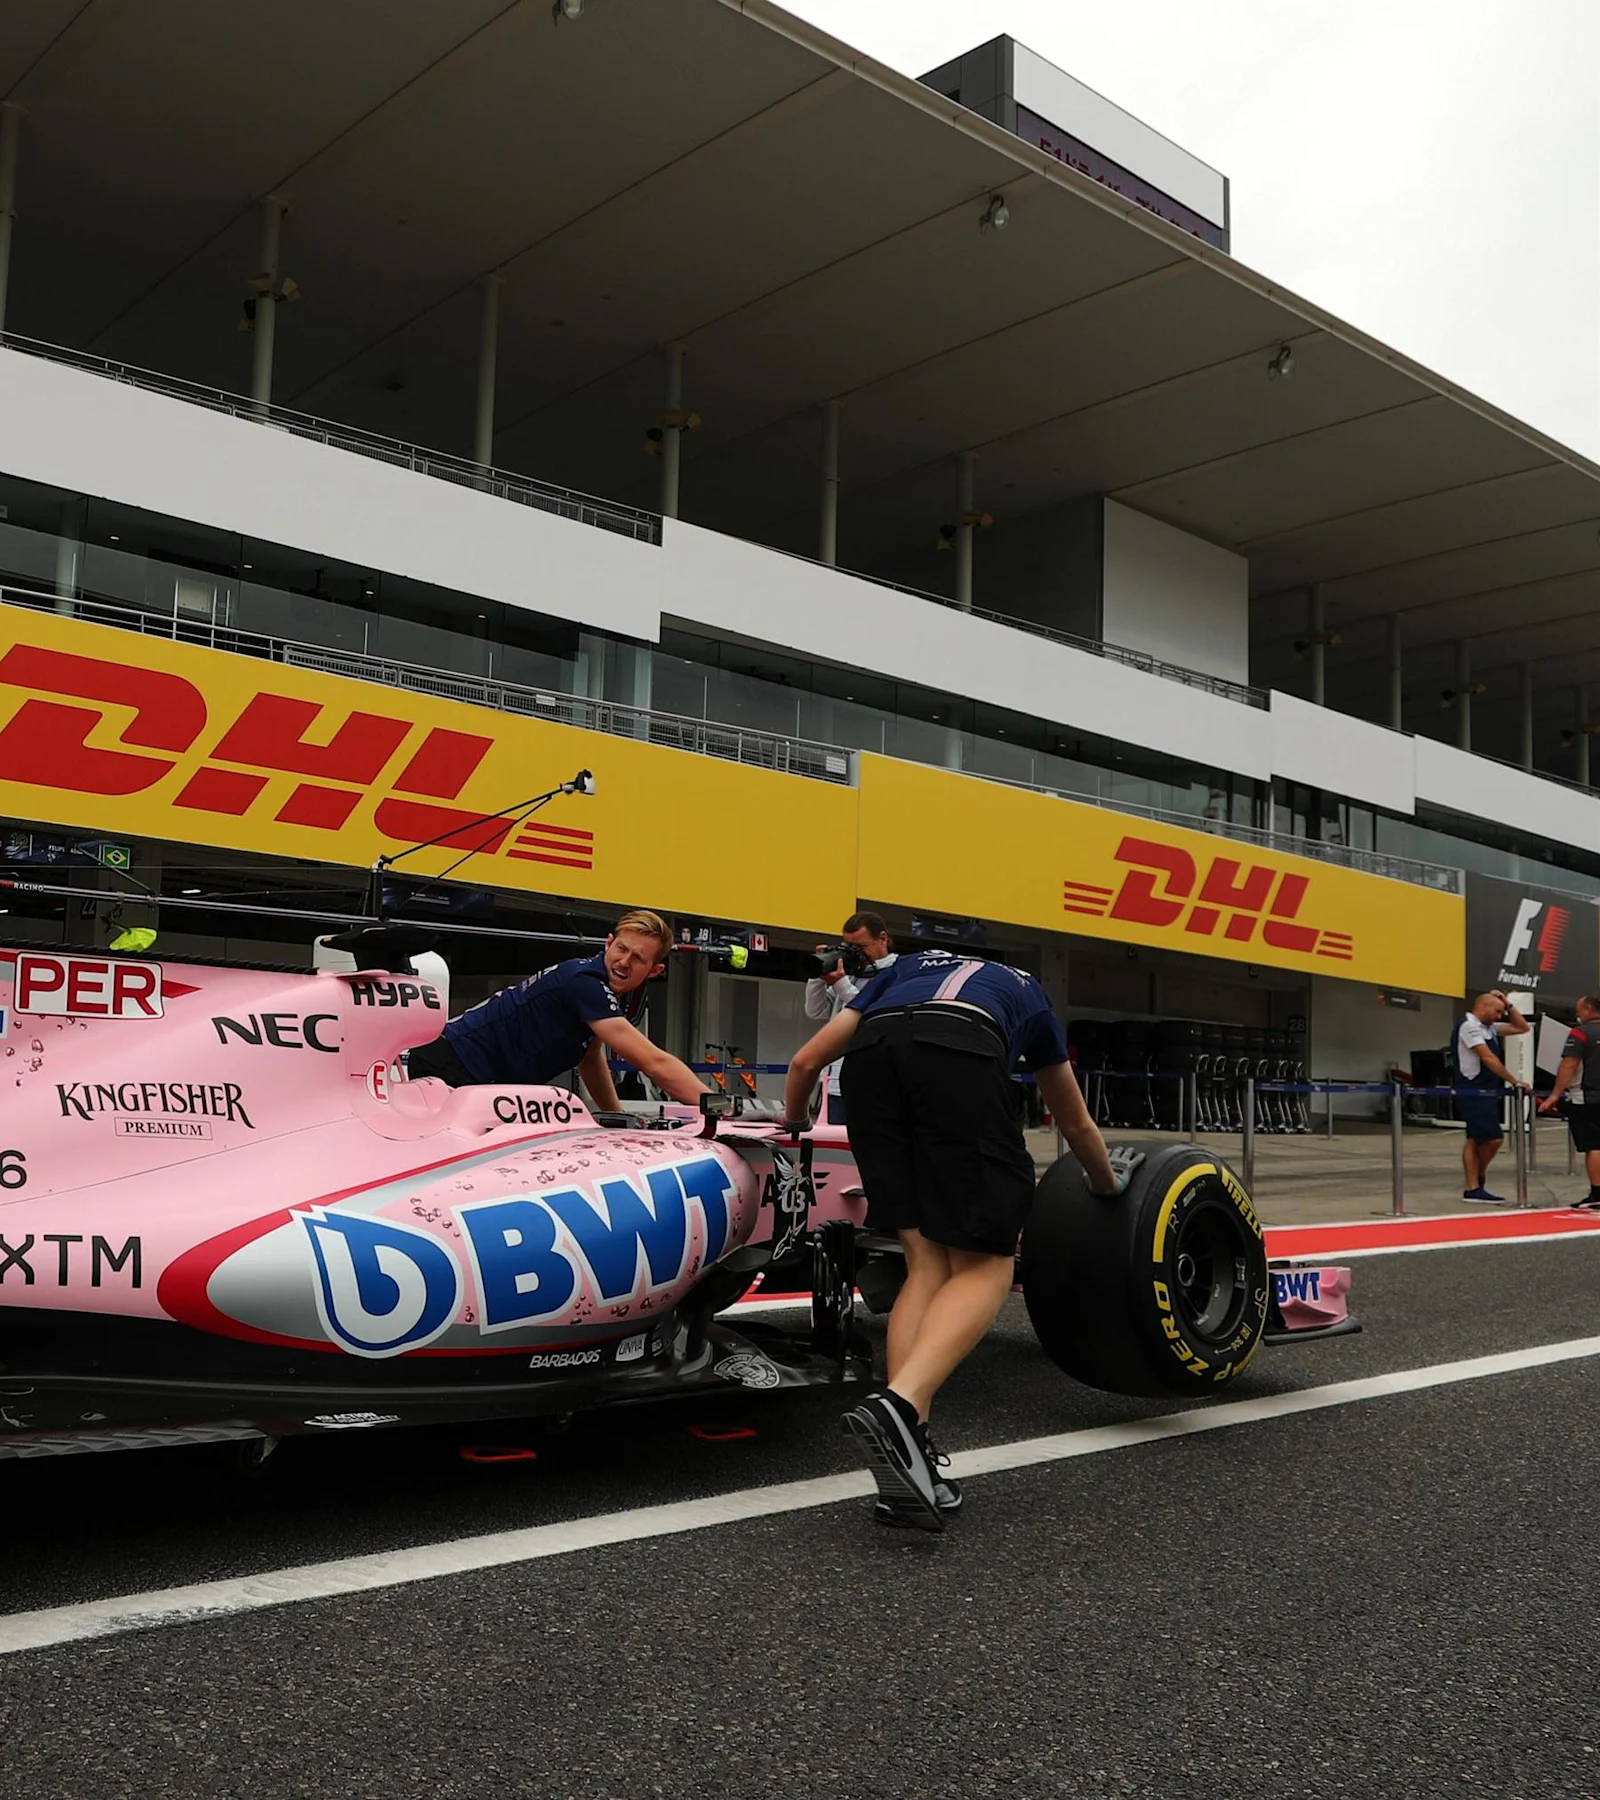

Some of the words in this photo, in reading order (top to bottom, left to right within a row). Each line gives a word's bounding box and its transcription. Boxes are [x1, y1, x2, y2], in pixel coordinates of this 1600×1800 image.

[13, 881, 44, 892] RACING
[1109, 836, 1321, 953] DHL
[18, 957, 158, 1015] PER
[1497, 968, 1532, 987] Formula
[350, 982, 441, 1010] HYPE
[212, 1013, 340, 1053] NEC
[373, 1065, 388, 1100] E
[56, 1082, 256, 1128] KINGFISHER
[493, 1095, 572, 1124] Claro
[124, 1121, 203, 1137] PREMIUM
[1221, 1165, 1264, 1240] PIRELLI
[454, 1153, 736, 1332] BWT
[1276, 1271, 1320, 1303] BWT
[1152, 1280, 1211, 1377] ZERO
[528, 1349, 602, 1369] BARBADOS
